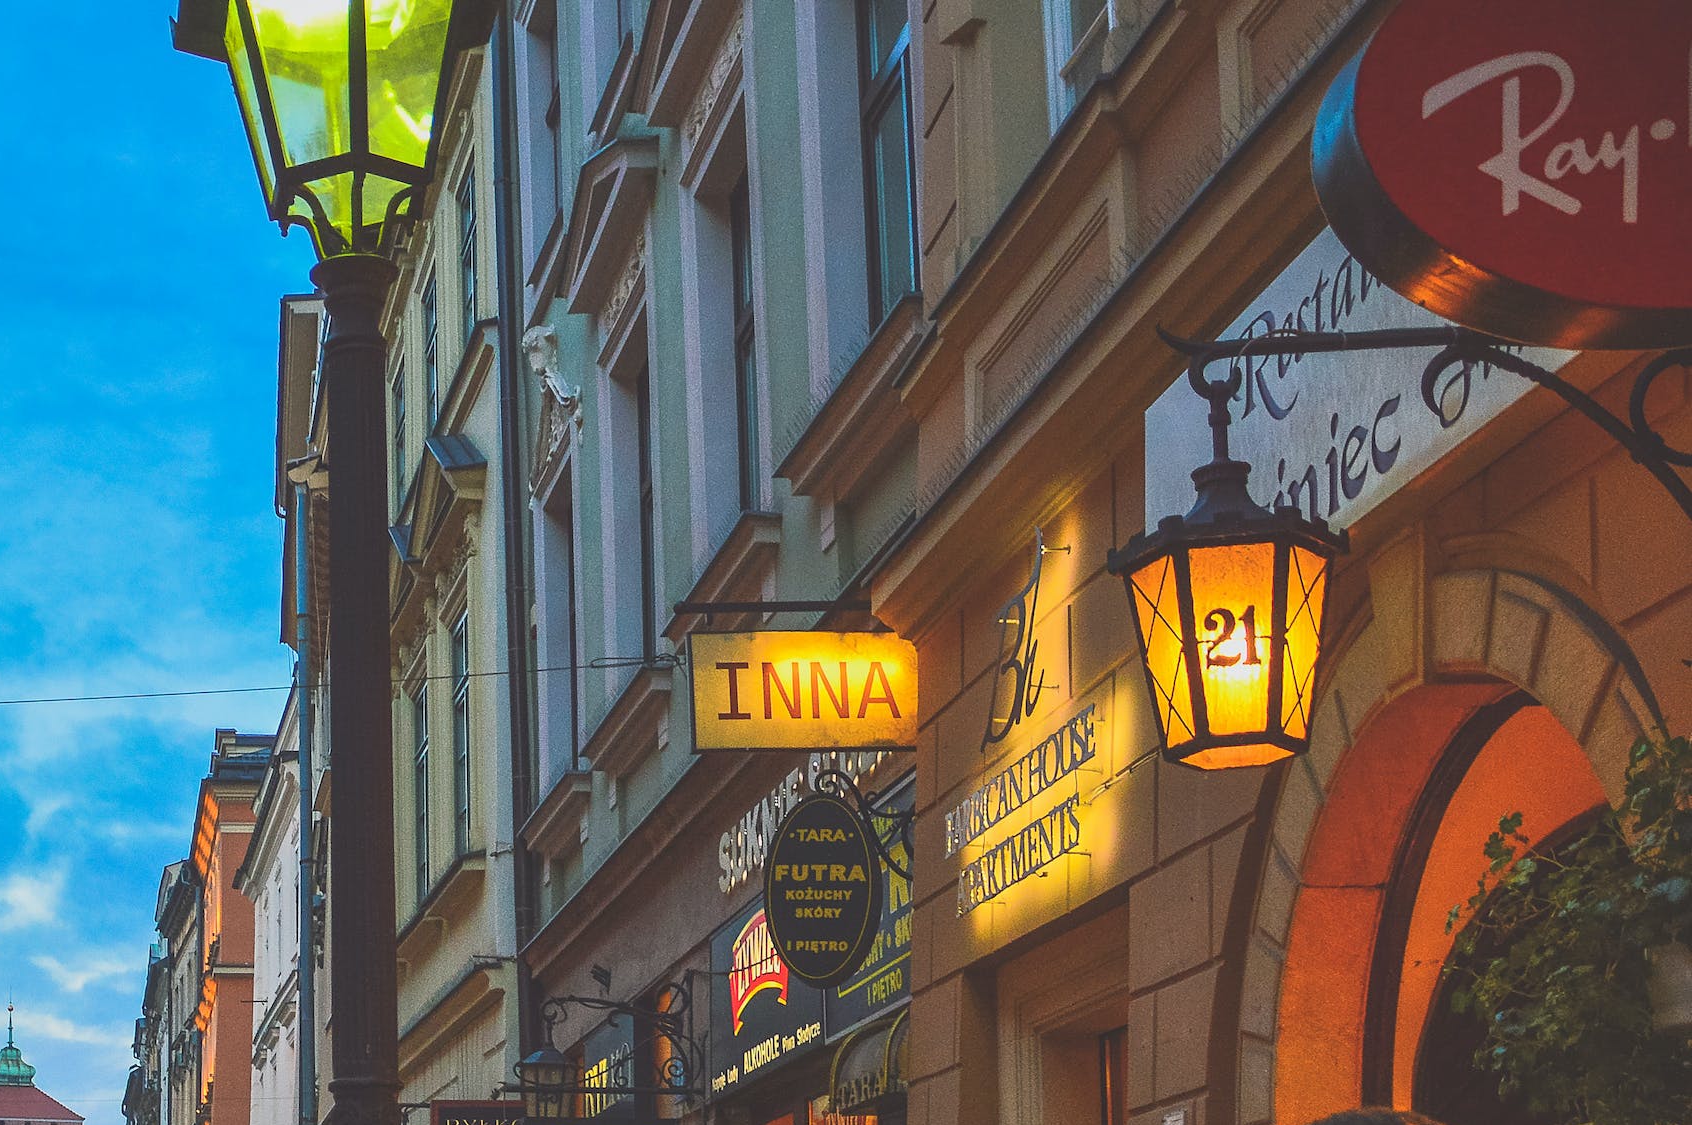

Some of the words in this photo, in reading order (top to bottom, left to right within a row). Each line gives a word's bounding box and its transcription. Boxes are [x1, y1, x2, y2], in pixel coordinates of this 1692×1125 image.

[1204, 605, 1261, 670] 21
[716, 661, 901, 720] INNA
[945, 764, 1024, 859] BARBICAN
[1029, 703, 1096, 800] HOUSE
[719, 767, 804, 894] SUKNIE
[796, 829, 847, 843] TARA
[774, 864, 867, 882] FUTRA
[956, 793, 1080, 918] APARTMENTS
[785, 887, 853, 901] KOŻUCHY
[795, 907, 843, 919] SKÓRY
[795, 940, 849, 953] PIĘTRO
[743, 1034, 781, 1075] ALKOHOLE
